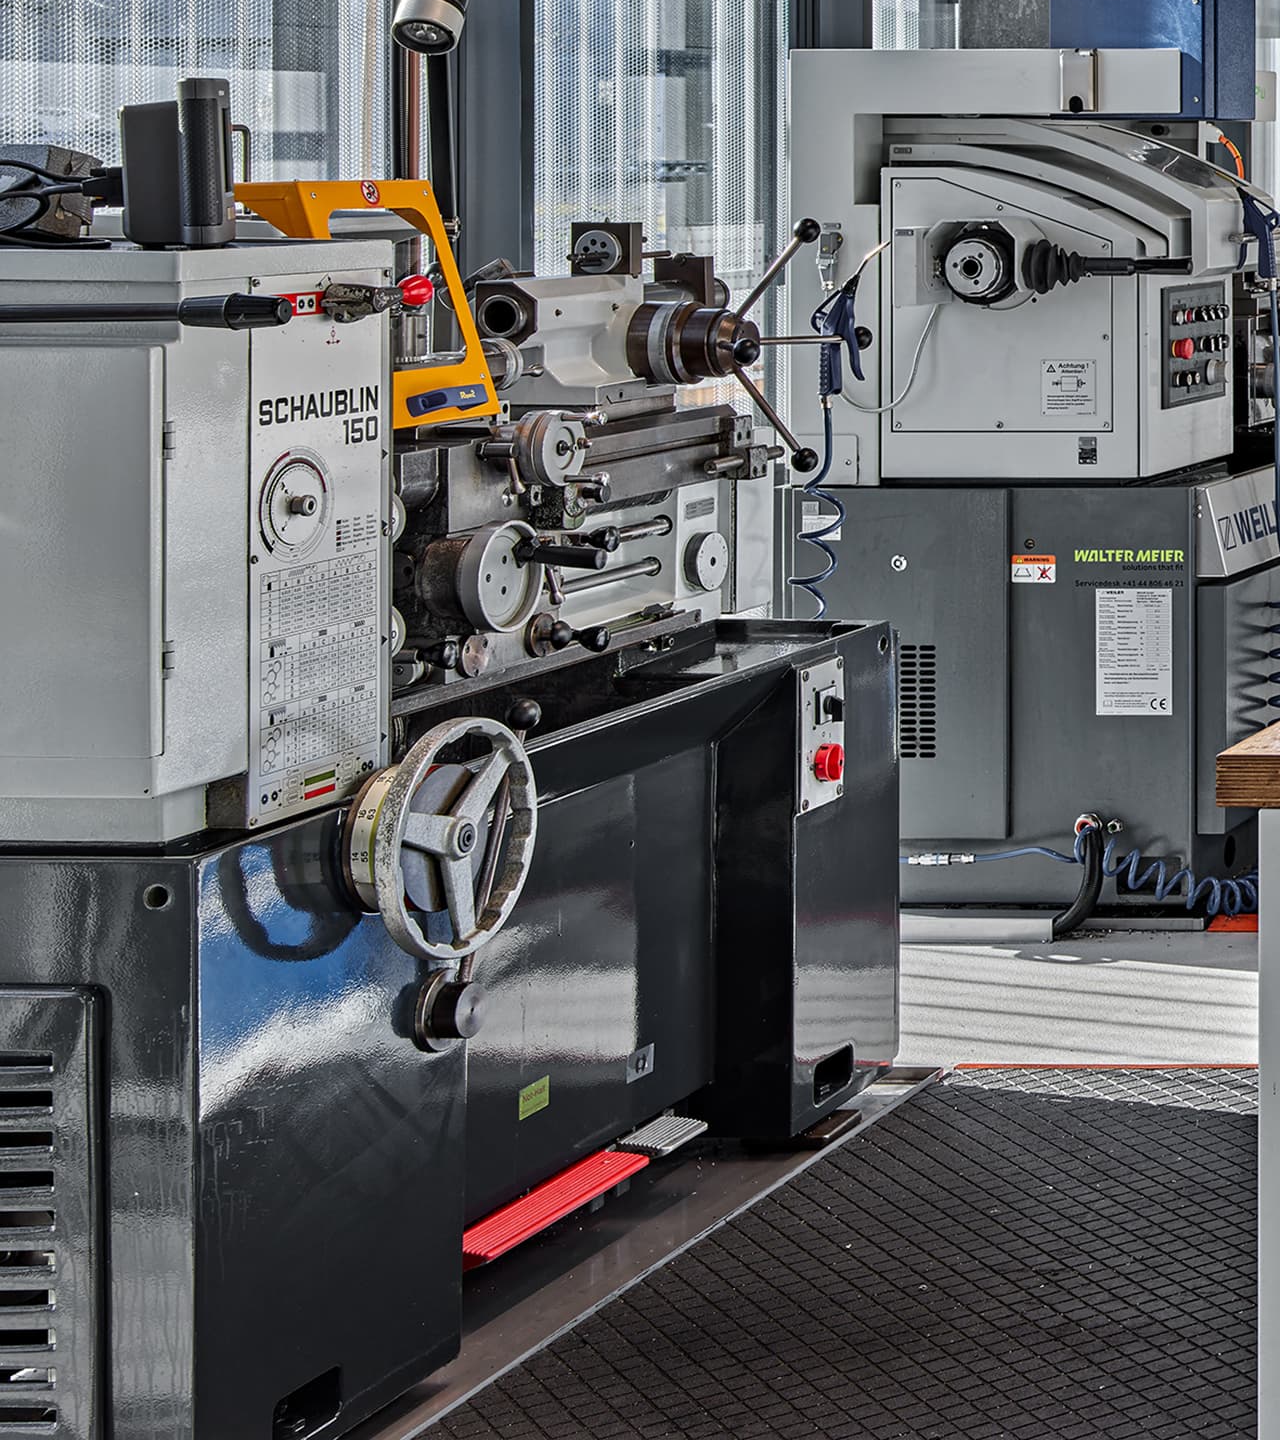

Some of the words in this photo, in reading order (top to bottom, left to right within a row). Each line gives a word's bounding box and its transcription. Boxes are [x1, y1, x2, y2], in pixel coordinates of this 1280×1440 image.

[259, 385, 378, 426] SCHAUBLIN
[343, 416, 377, 445] 150
[1074, 550, 1134, 562] WALTER
[1136, 550, 1185, 562] MEIER
[1122, 563, 1157, 571] solutions
[1158, 563, 1174, 571] that
[358, 809, 366, 819] 16
[367, 808, 376, 820] 63
[361, 851, 368, 862] 55
